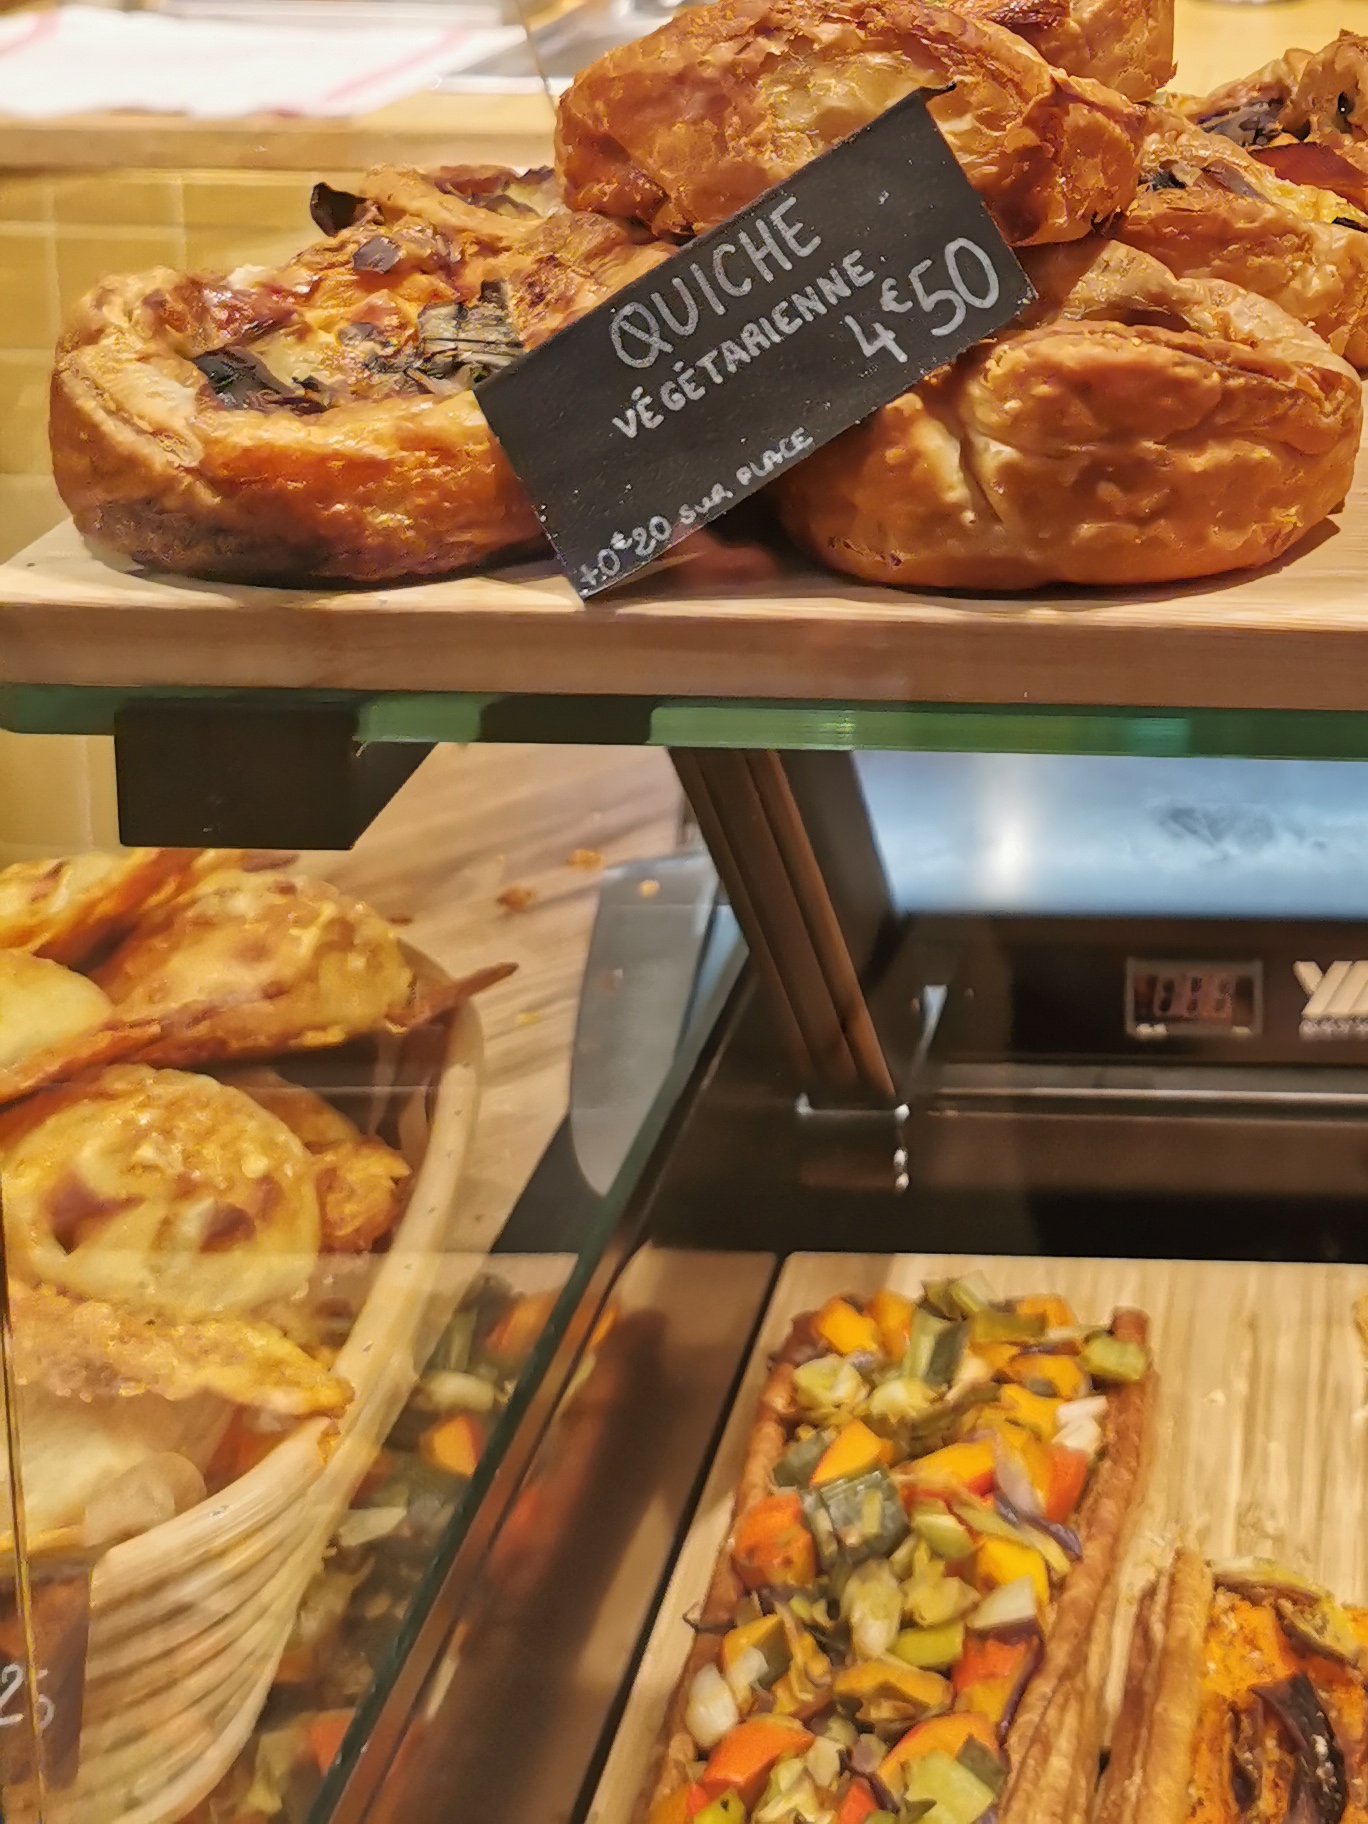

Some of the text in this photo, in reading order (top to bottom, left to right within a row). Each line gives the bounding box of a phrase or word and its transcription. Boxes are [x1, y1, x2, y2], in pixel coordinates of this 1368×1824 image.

[609, 195, 823, 370] QUICHE
[611, 248, 877, 440] VÉGÉTARIENNE
[735, 426, 815, 486] PLACE
